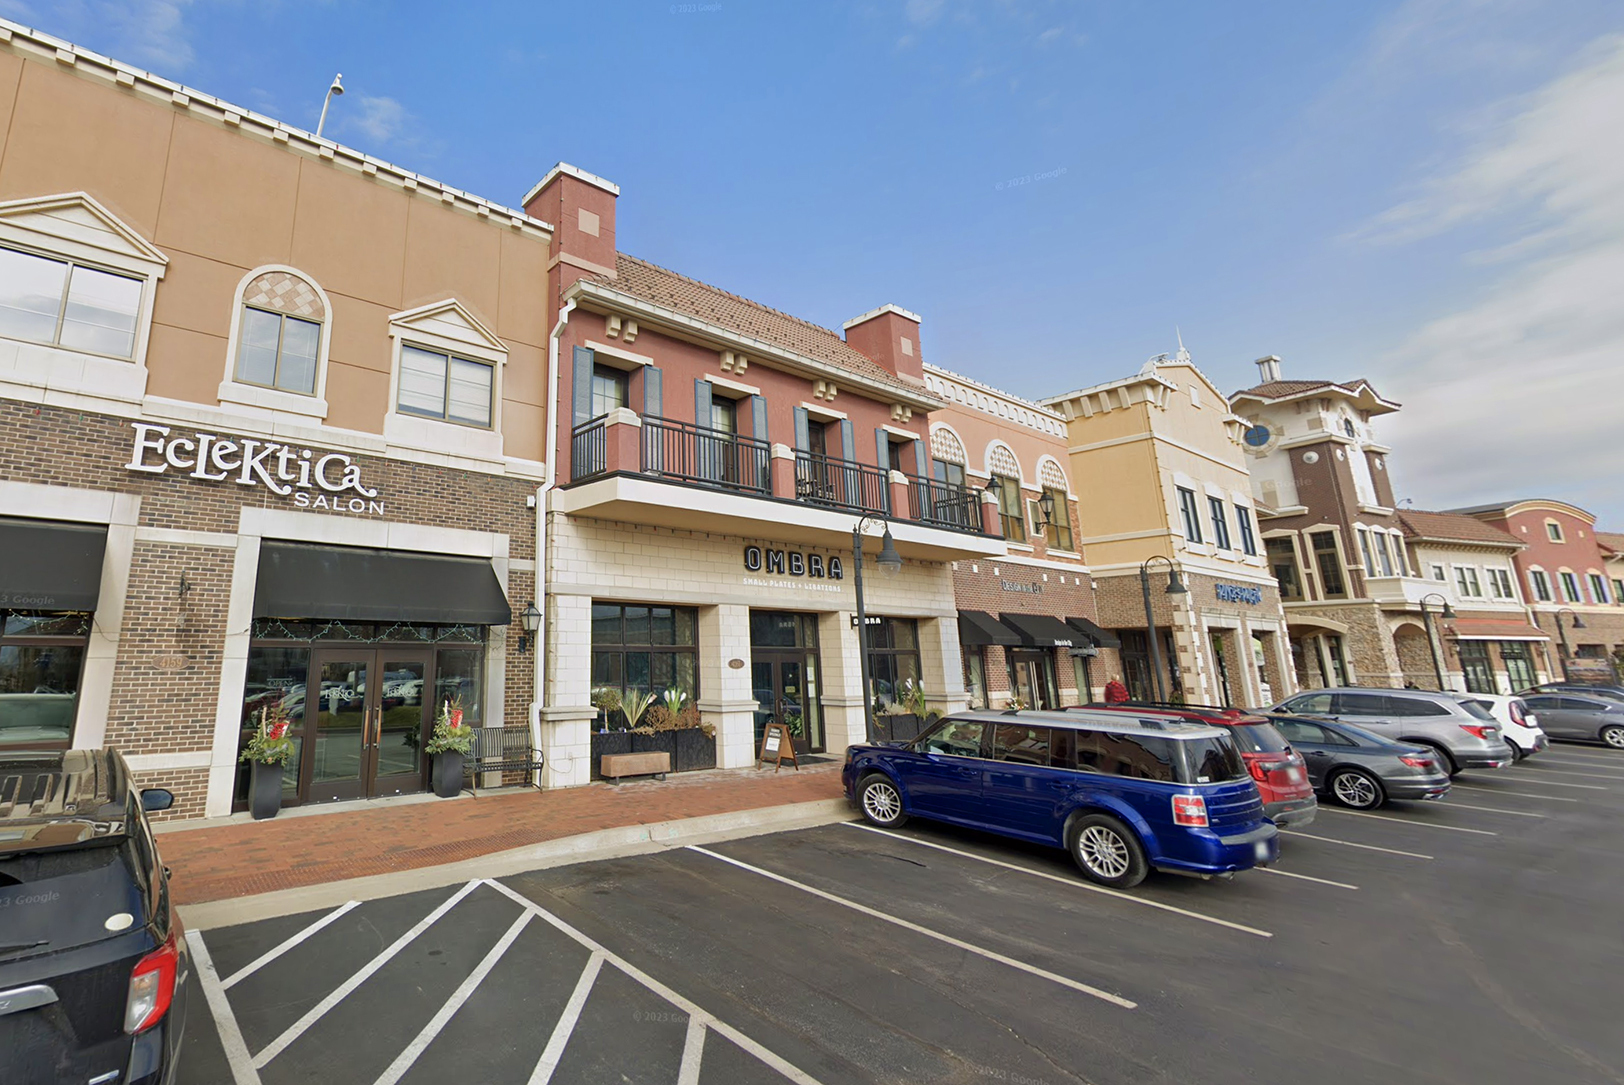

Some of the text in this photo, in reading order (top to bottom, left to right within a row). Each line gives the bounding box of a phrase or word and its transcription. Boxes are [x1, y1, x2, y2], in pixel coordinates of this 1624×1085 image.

[294, 492, 385, 516] SALON
[744, 545, 843, 580] OMBRA
[743, 577, 768, 586] SMALL
[769, 579, 796, 589] PLATES
[804, 583, 841, 593] LIBATIONS
[853, 617, 881, 625] OBRA
[160, 656, 183, 668] 4159
